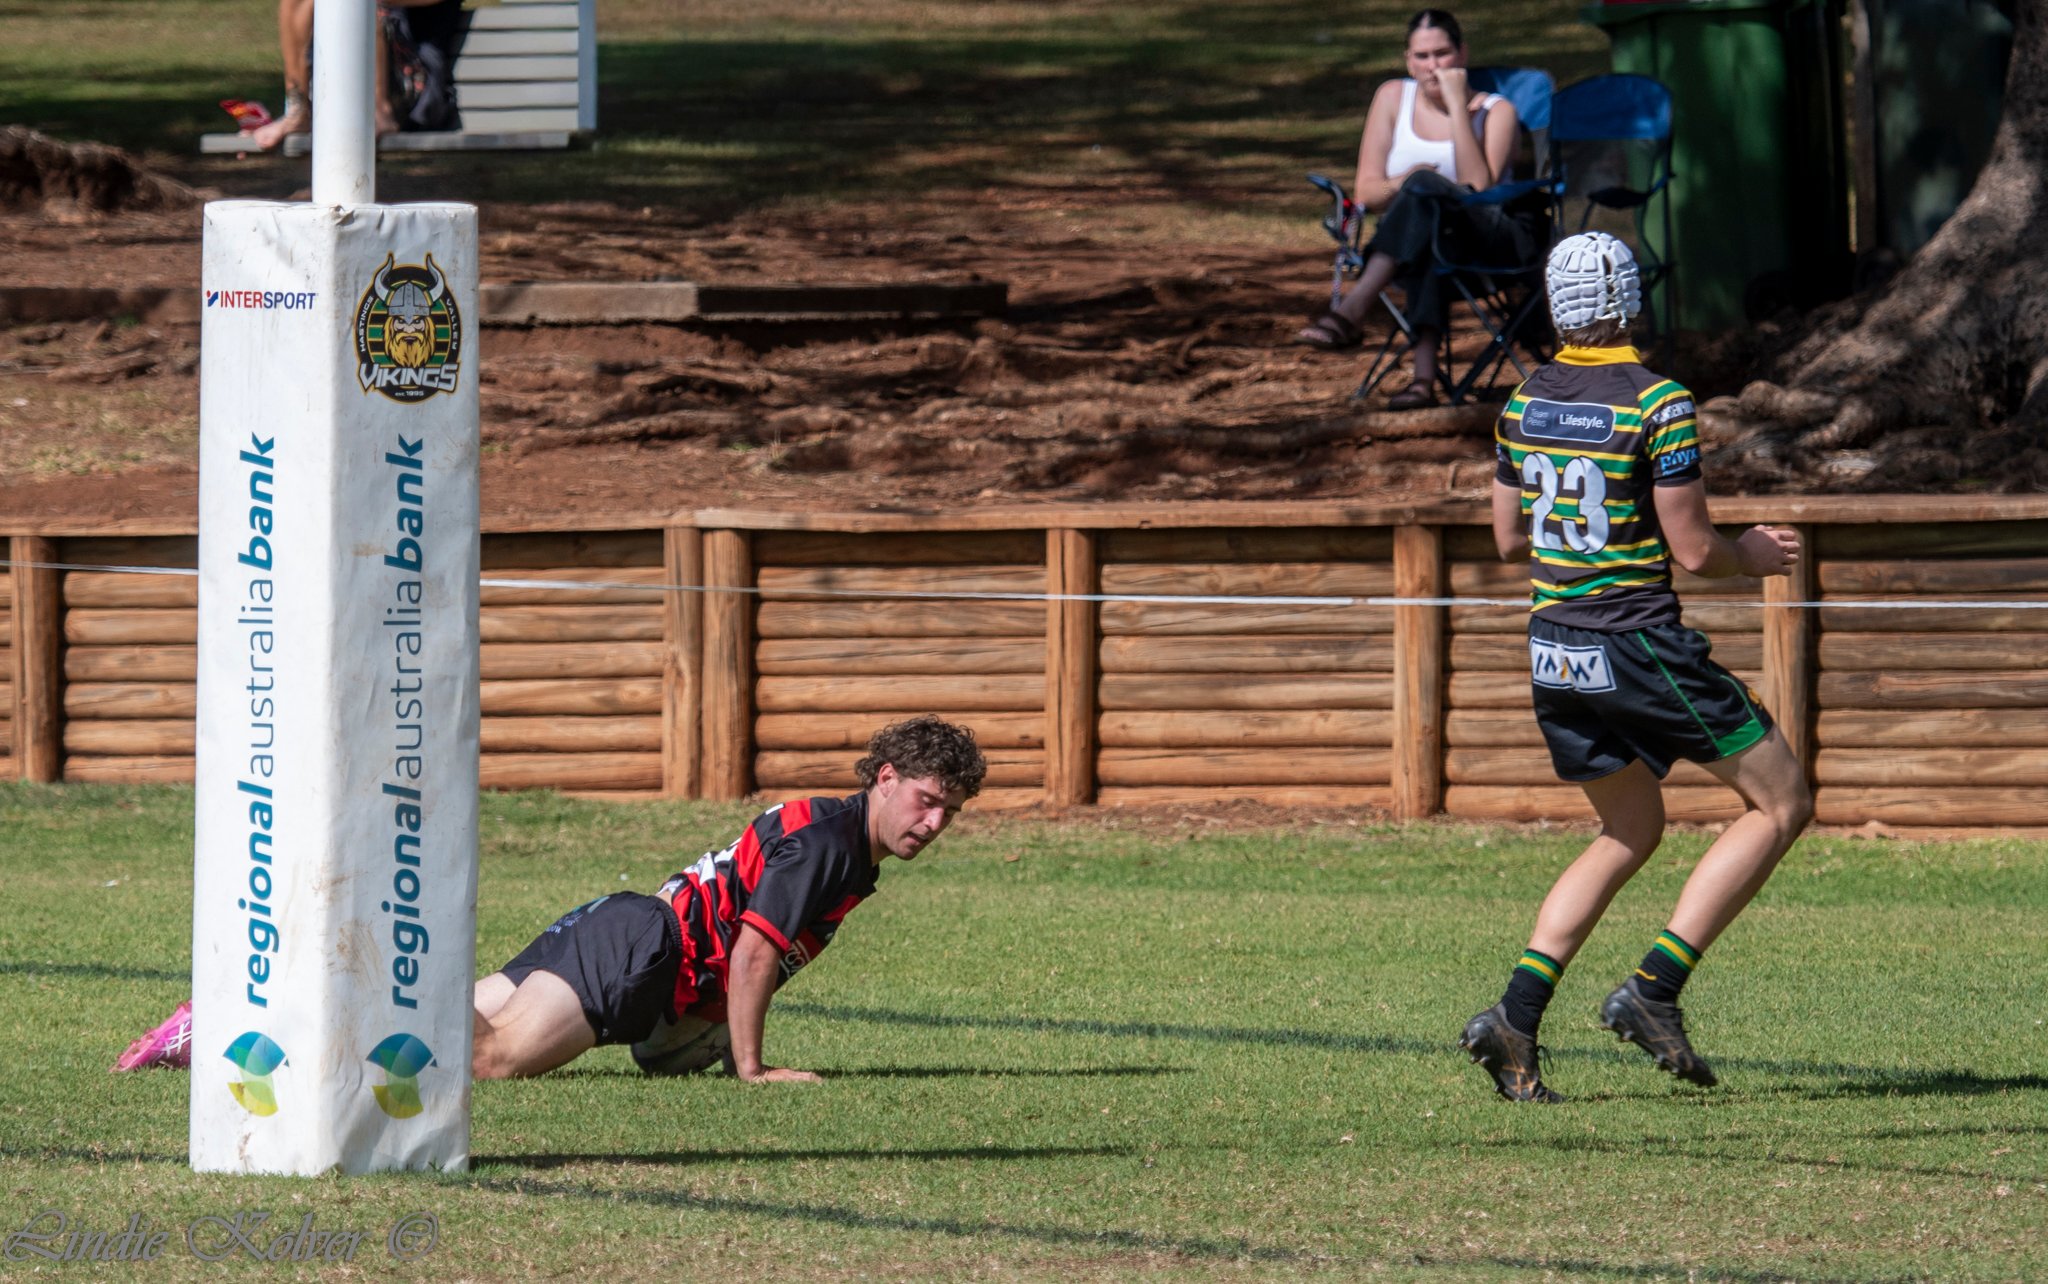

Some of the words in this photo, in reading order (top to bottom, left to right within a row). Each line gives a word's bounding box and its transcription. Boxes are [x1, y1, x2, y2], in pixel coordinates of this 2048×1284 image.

[220, 290, 316, 309] INTERSPORT
[359, 295, 375, 352] HASTINGS
[446, 298, 458, 350] VALLEY
[360, 362, 458, 391] VIKINGS
[1559, 408, 1607, 430] Lifestyle.
[1521, 451, 1610, 555] 23
